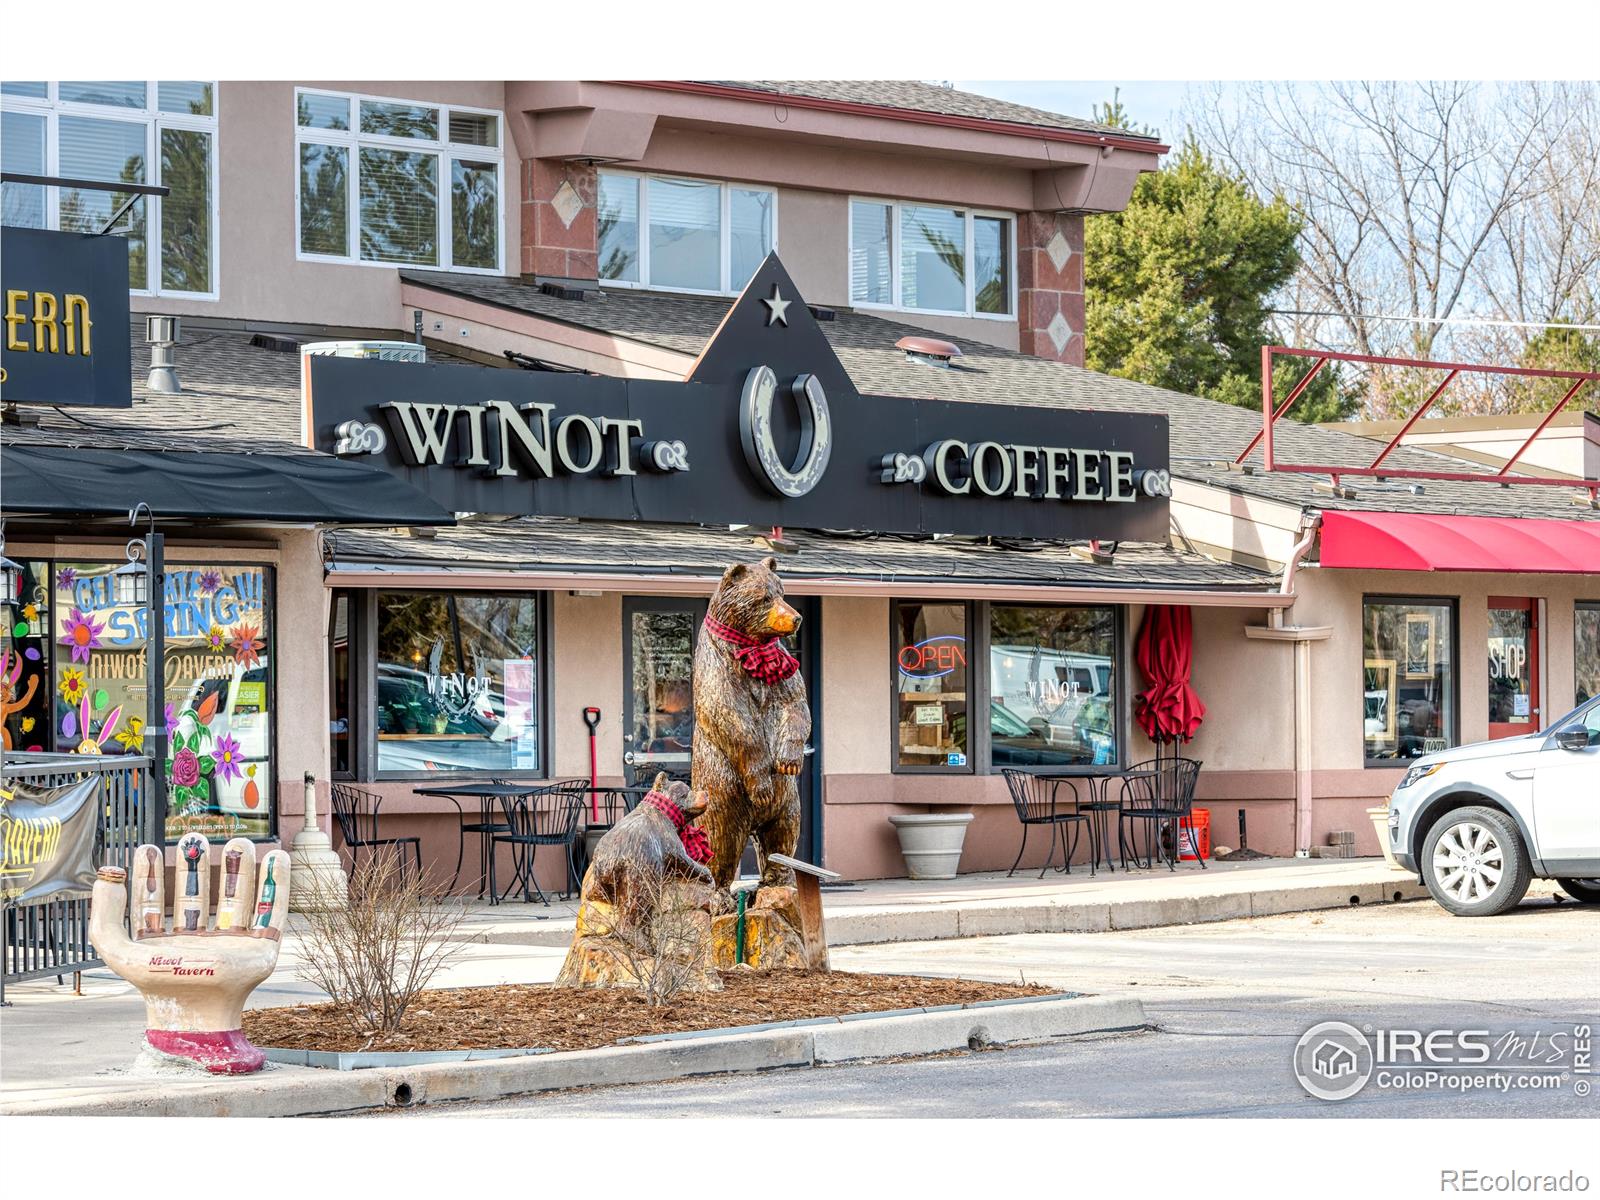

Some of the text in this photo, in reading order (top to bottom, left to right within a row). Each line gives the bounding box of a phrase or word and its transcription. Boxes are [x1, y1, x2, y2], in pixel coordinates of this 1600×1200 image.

[379, 400, 1136, 502] WINOT COFFEE
[74, 571, 203, 613] CELATE
[899, 645, 967, 669] OPEN
[1490, 644, 1526, 679] SHOP
[235, 691, 259, 699] ASIER
[426, 673, 492, 698] WINOT
[1028, 679, 1080, 704] WINOT
[173, 967, 215, 976] Tavern
